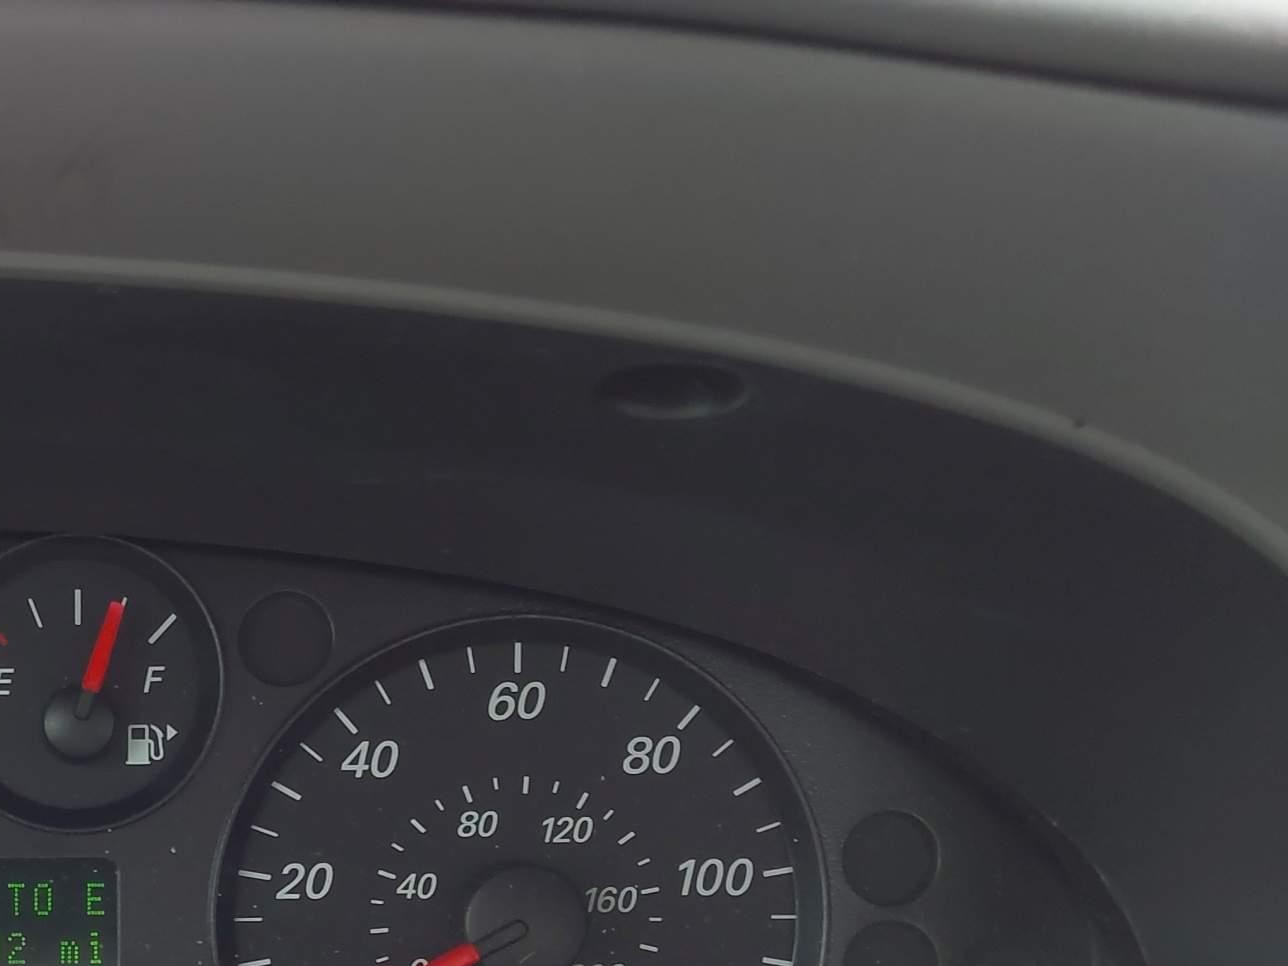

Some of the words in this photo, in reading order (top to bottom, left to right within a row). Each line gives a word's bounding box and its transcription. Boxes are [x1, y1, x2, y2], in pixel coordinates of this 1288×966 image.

[143, 665, 167, 693] F
[487, 681, 546, 721] 60
[340, 740, 399, 778] 40
[622, 735, 681, 775] 80
[457, 810, 499, 838] 80
[542, 816, 594, 843] 120
[275, 862, 333, 900] 20
[396, 873, 437, 900] 40
[677, 858, 754, 896] 100
[8, 882, 54, 918] TO
[86, 882, 106, 916] E
[585, 886, 638, 913] 160
[60, 932, 105, 966] mi
